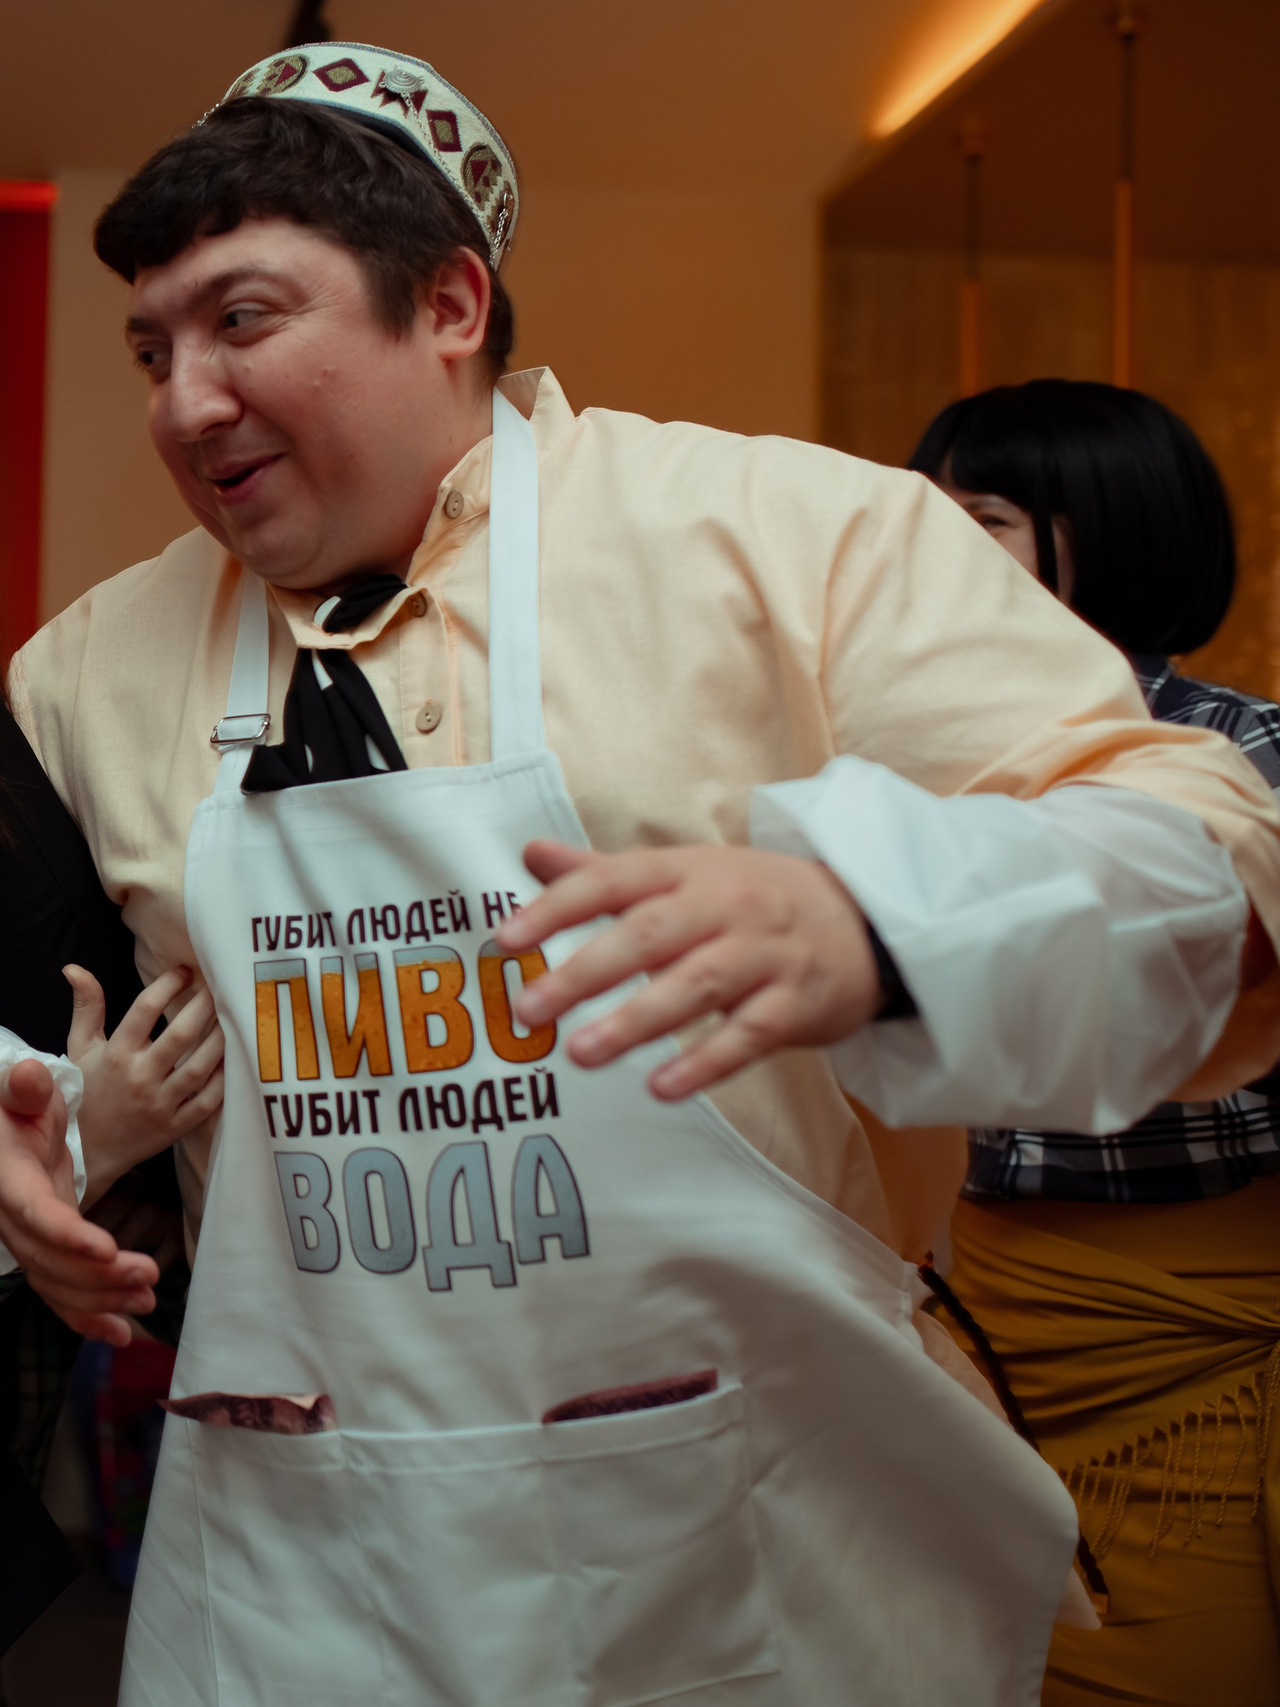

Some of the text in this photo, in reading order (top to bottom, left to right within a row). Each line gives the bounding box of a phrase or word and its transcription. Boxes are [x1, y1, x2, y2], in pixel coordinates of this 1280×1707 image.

[251, 912, 337, 953] ГУБИТ
[347, 889, 471, 944] ЛЮДЕЙ
[254, 939, 558, 1083] ПИВО
[263, 1067, 560, 1138] ГУБИТ ЛЮДЕЙ
[273, 1133, 590, 1292] ВОДА
